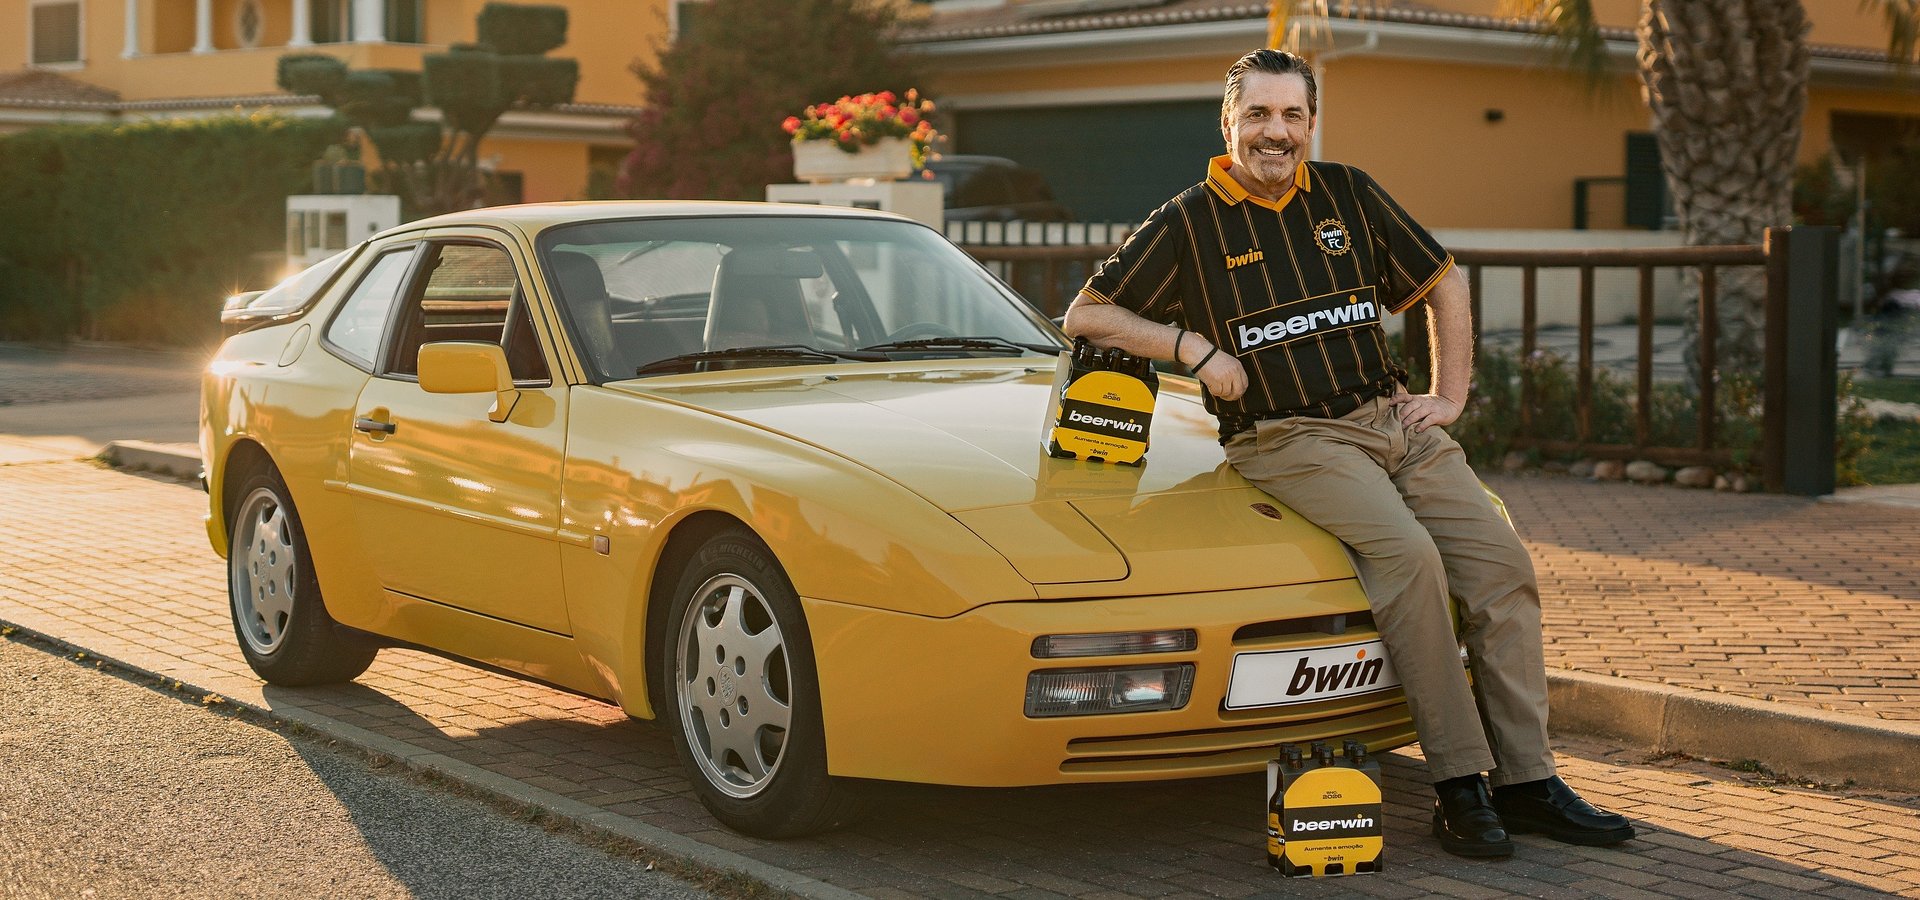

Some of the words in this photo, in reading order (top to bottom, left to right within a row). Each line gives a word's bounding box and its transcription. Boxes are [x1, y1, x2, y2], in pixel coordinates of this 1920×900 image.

[1321, 228, 1343, 240] bwin
[1328, 238, 1343, 249] FC
[1226, 248, 1263, 269] bwin
[1238, 295, 1375, 349] beerwin
[1069, 410, 1143, 433] beerwin
[1074, 435, 1100, 445] Aumenta
[1093, 448, 1109, 456] bwin
[720, 544, 765, 570] MICHELIN
[1285, 649, 1384, 696] bwin
[1293, 813, 1373, 832] beerwin
[1327, 854, 1344, 862] bwin
